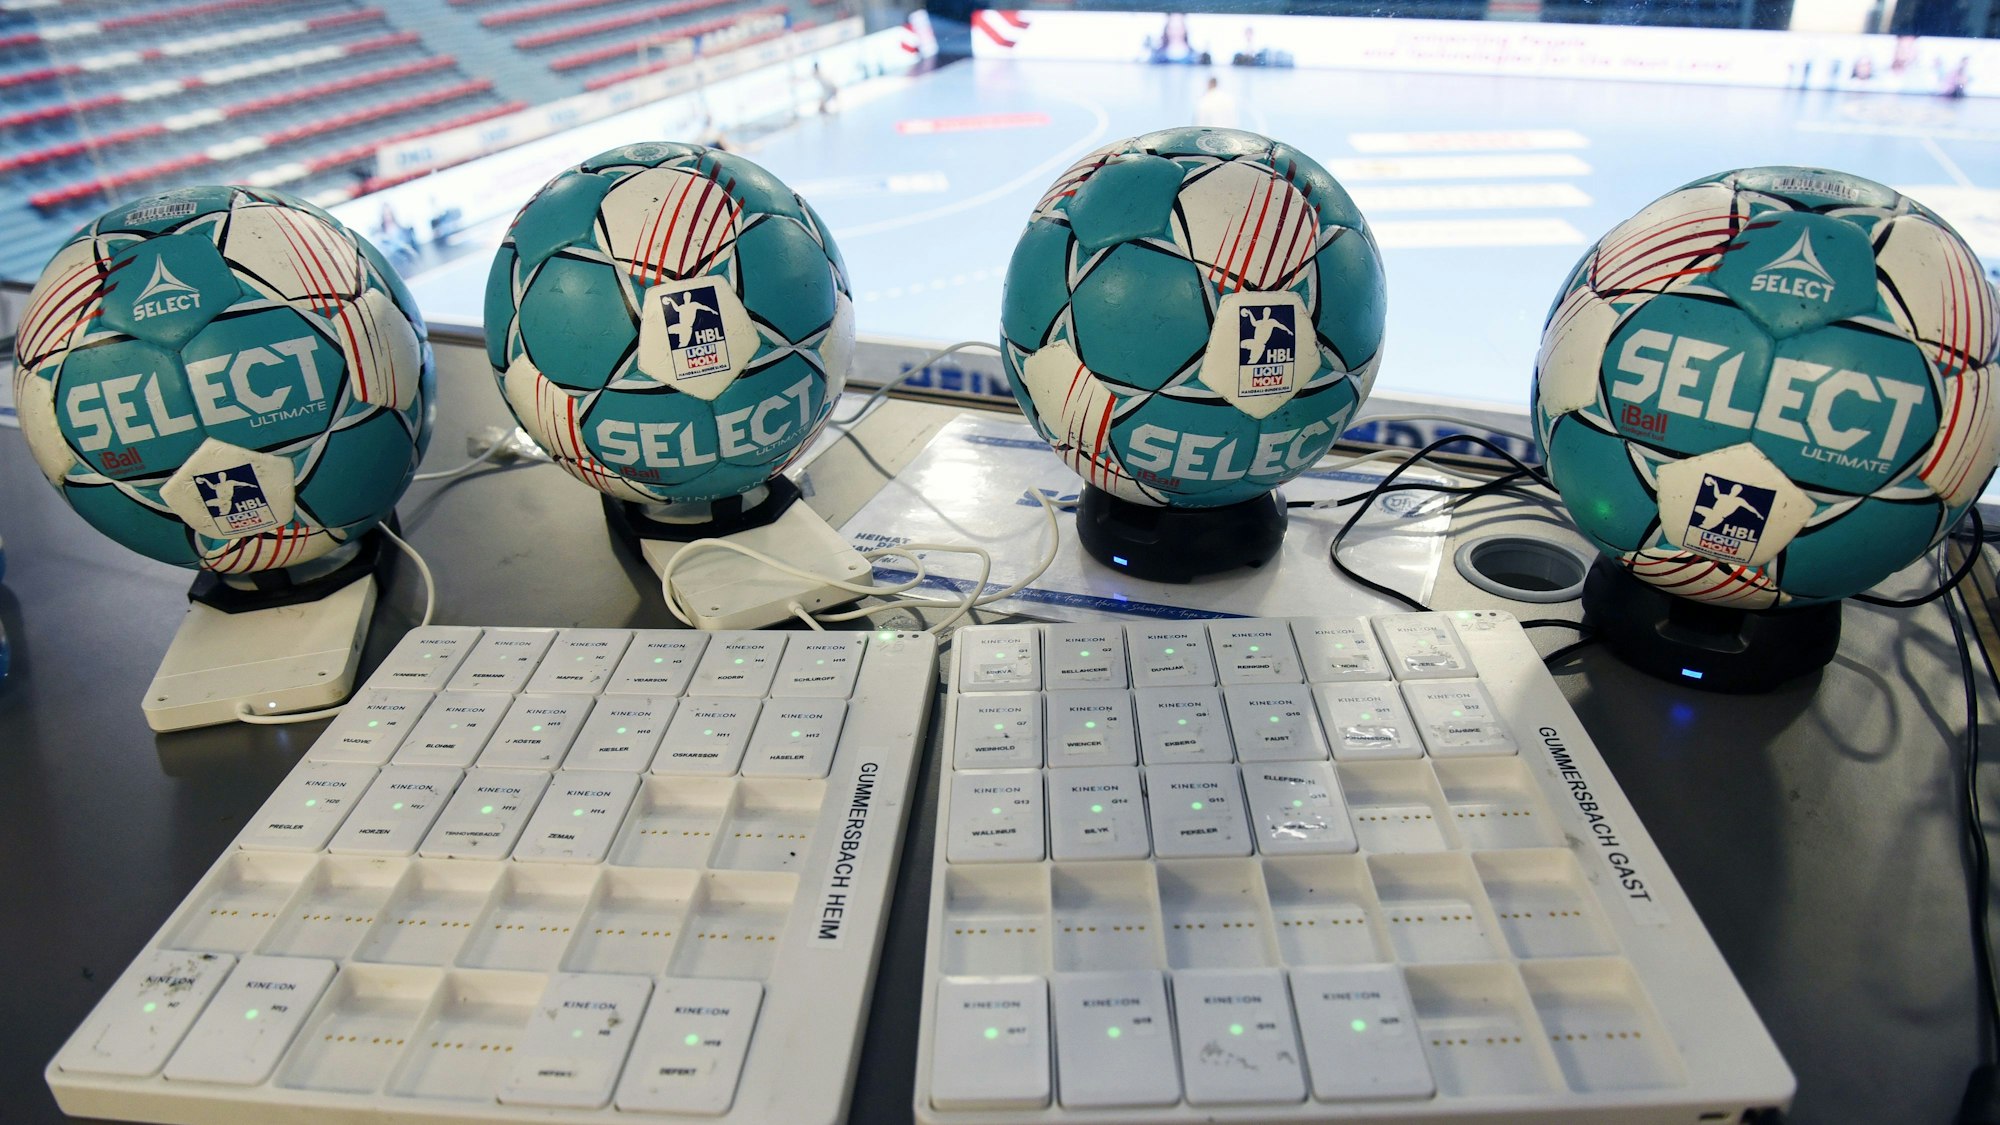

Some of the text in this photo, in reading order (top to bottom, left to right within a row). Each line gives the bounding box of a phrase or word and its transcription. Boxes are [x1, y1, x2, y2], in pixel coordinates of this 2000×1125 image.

[1750, 273, 1835, 303] SELECT
[133, 294, 201, 322] SELECT
[694, 327, 725, 345] HBL
[688, 354, 718, 368] MOLY
[1266, 348, 1294, 364] HBL
[1253, 376, 1283, 387] MOLY
[66, 335, 325, 453] SELECT
[1612, 327, 1926, 462] SELECT
[248, 401, 328, 429] ULTIMATE
[596, 373, 816, 468] SELECT
[1621, 403, 1668, 434] iBall
[1126, 400, 1356, 482] SELECT
[1801, 446, 1891, 475] ULTIMATE
[618, 465, 661, 481] iBall
[1136, 467, 1181, 488] iBall
[235, 497, 267, 512] HBL
[230, 517, 262, 529] MOLY
[854, 532, 911, 545] HEIMAT
[1721, 523, 1758, 542] HBL
[1700, 540, 1738, 556] MOLY
[304, 780, 348, 788] KINEXON
[1170, 782, 1218, 790] KINEXON
[1264, 775, 1304, 784] ELLEFSEN
[477, 786, 521, 794] KINEXON
[974, 786, 1022, 794] KINEXON
[1072, 785, 1120, 793] KINEXON
[1538, 726, 1653, 903] GUMMERSBACH GAST
[972, 828, 1017, 837] WALLINIUS
[1084, 826, 1111, 835] BILYK
[1180, 828, 1218, 836] PEKELER
[818, 761, 879, 940] GUMMERSBACH HEIM
[246, 981, 297, 991] KINEXON
[564, 1000, 617, 1010] KINEXON
[964, 1001, 1021, 1010] KINEXON
[1082, 998, 1140, 1008] KINEXON
[674, 1006, 730, 1016] KINEXON
